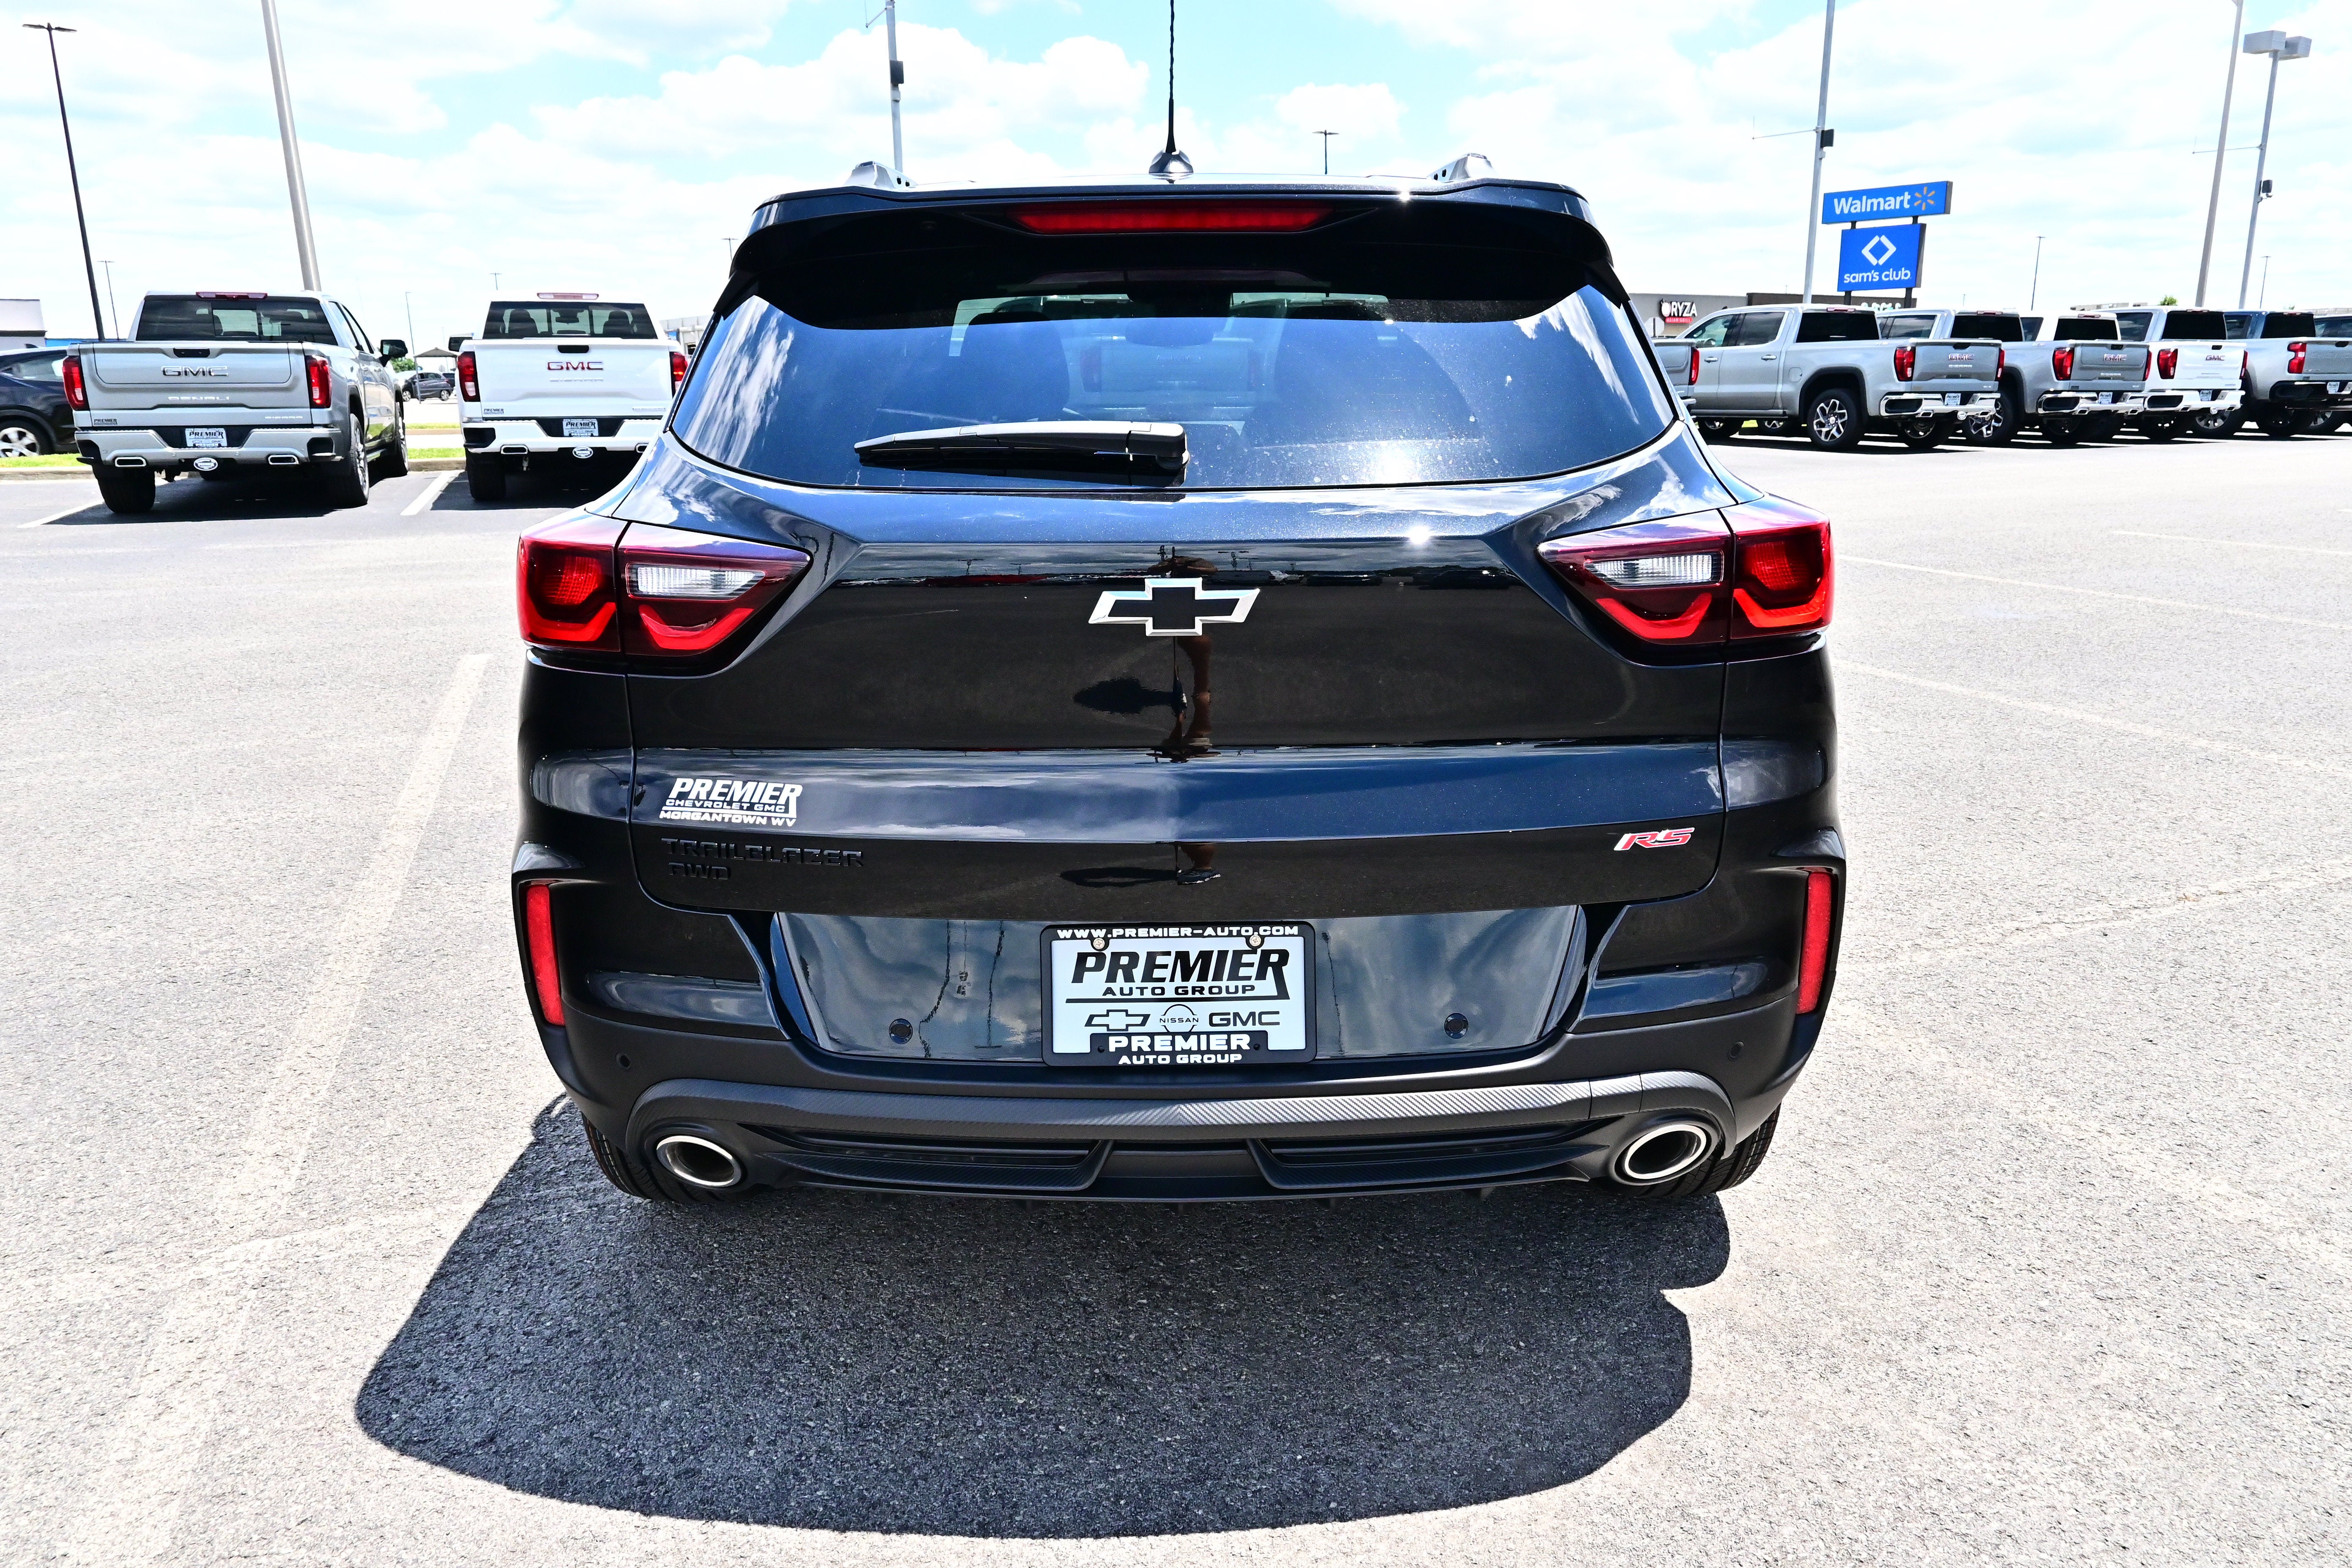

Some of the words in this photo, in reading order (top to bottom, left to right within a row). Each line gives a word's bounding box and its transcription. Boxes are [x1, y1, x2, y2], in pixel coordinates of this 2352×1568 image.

[1833, 191, 1911, 215] Walmart
[1843, 270, 1879, 283] sam's
[1881, 267, 1911, 281] club
[161, 365, 229, 376] GMC
[547, 361, 604, 370] GMC
[666, 799, 750, 810] CHEVROLET
[754, 804, 785, 812] GMC
[668, 778, 803, 818] PREMIER
[659, 811, 767, 825] MORGANTOWN
[771, 818, 796, 827] WV
[1614, 827, 1695, 851] RS
[661, 838, 864, 867] TRAILBLAZER
[668, 862, 731, 880] AWD
[1056, 926, 1298, 939] WWW.PREMIER-AUTO.COM
[1071, 949, 1290, 1000] PREMIER
[1102, 986, 1165, 996] AUTO
[1175, 984, 1255, 995] GROUP
[1209, 1011, 1280, 1026] GMC
[1108, 1034, 1250, 1052] PREMIER
[1118, 1054, 1170, 1064] AUTO
[1176, 1053, 1243, 1064] GROUP
